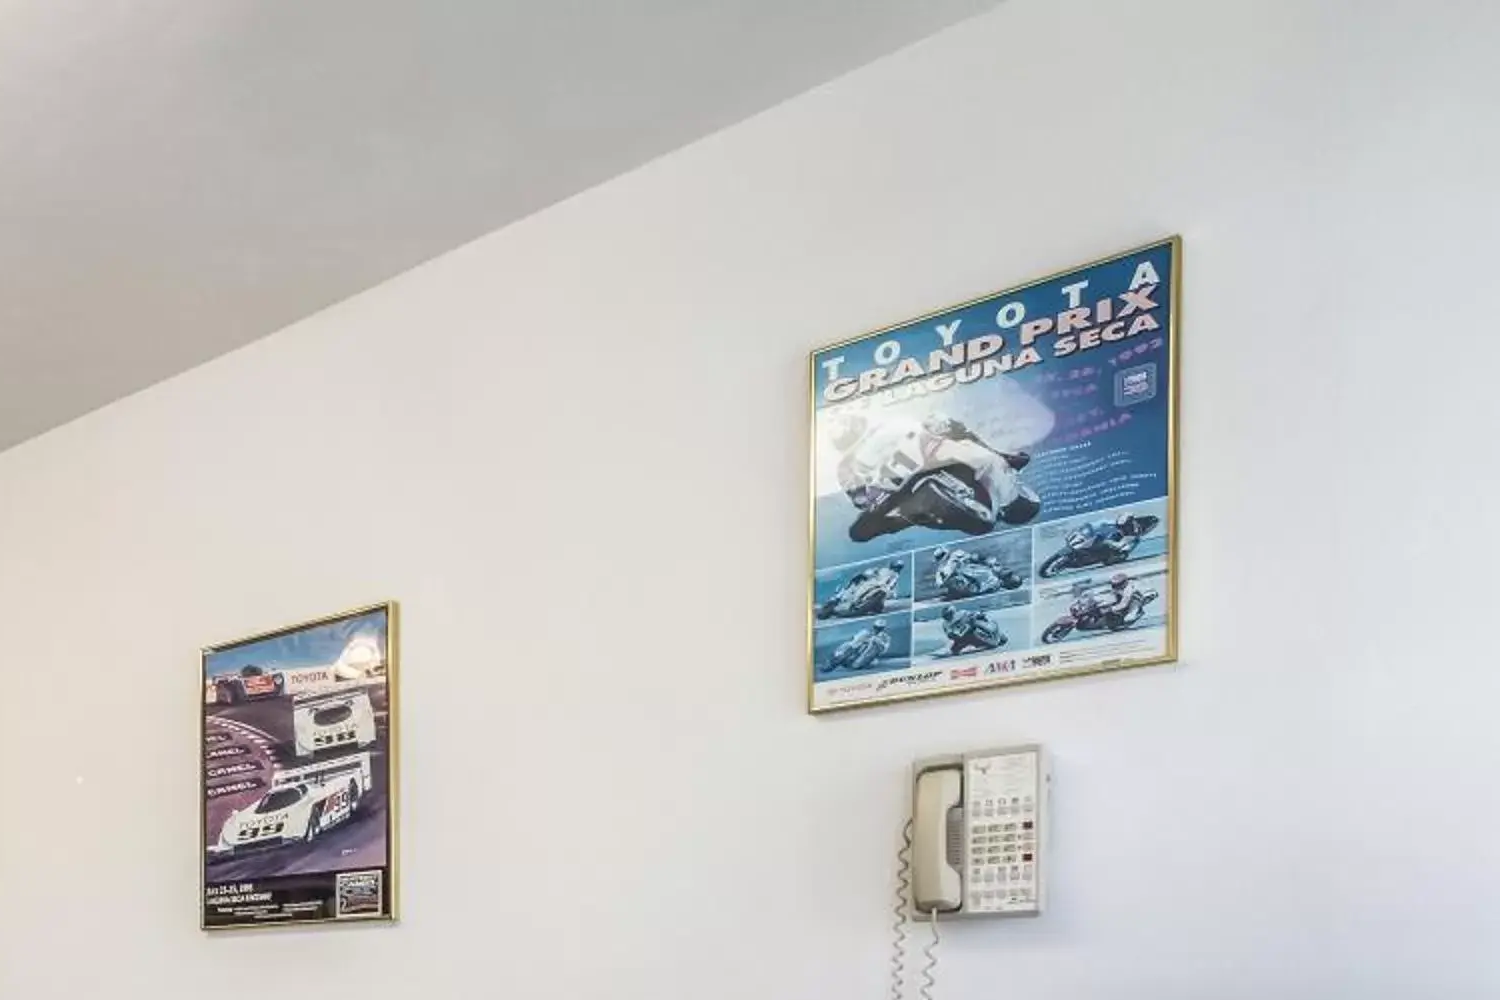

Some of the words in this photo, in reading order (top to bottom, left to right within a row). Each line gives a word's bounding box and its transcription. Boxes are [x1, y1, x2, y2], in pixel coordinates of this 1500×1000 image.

[822, 260, 1161, 380] TOYOTA
[823, 334, 1004, 403] GRAND
[1019, 284, 1161, 346] PRIX
[882, 346, 1044, 407] LAGUNA
[1053, 313, 1161, 357] SECA
[291, 671, 329, 684] TOYOTA
